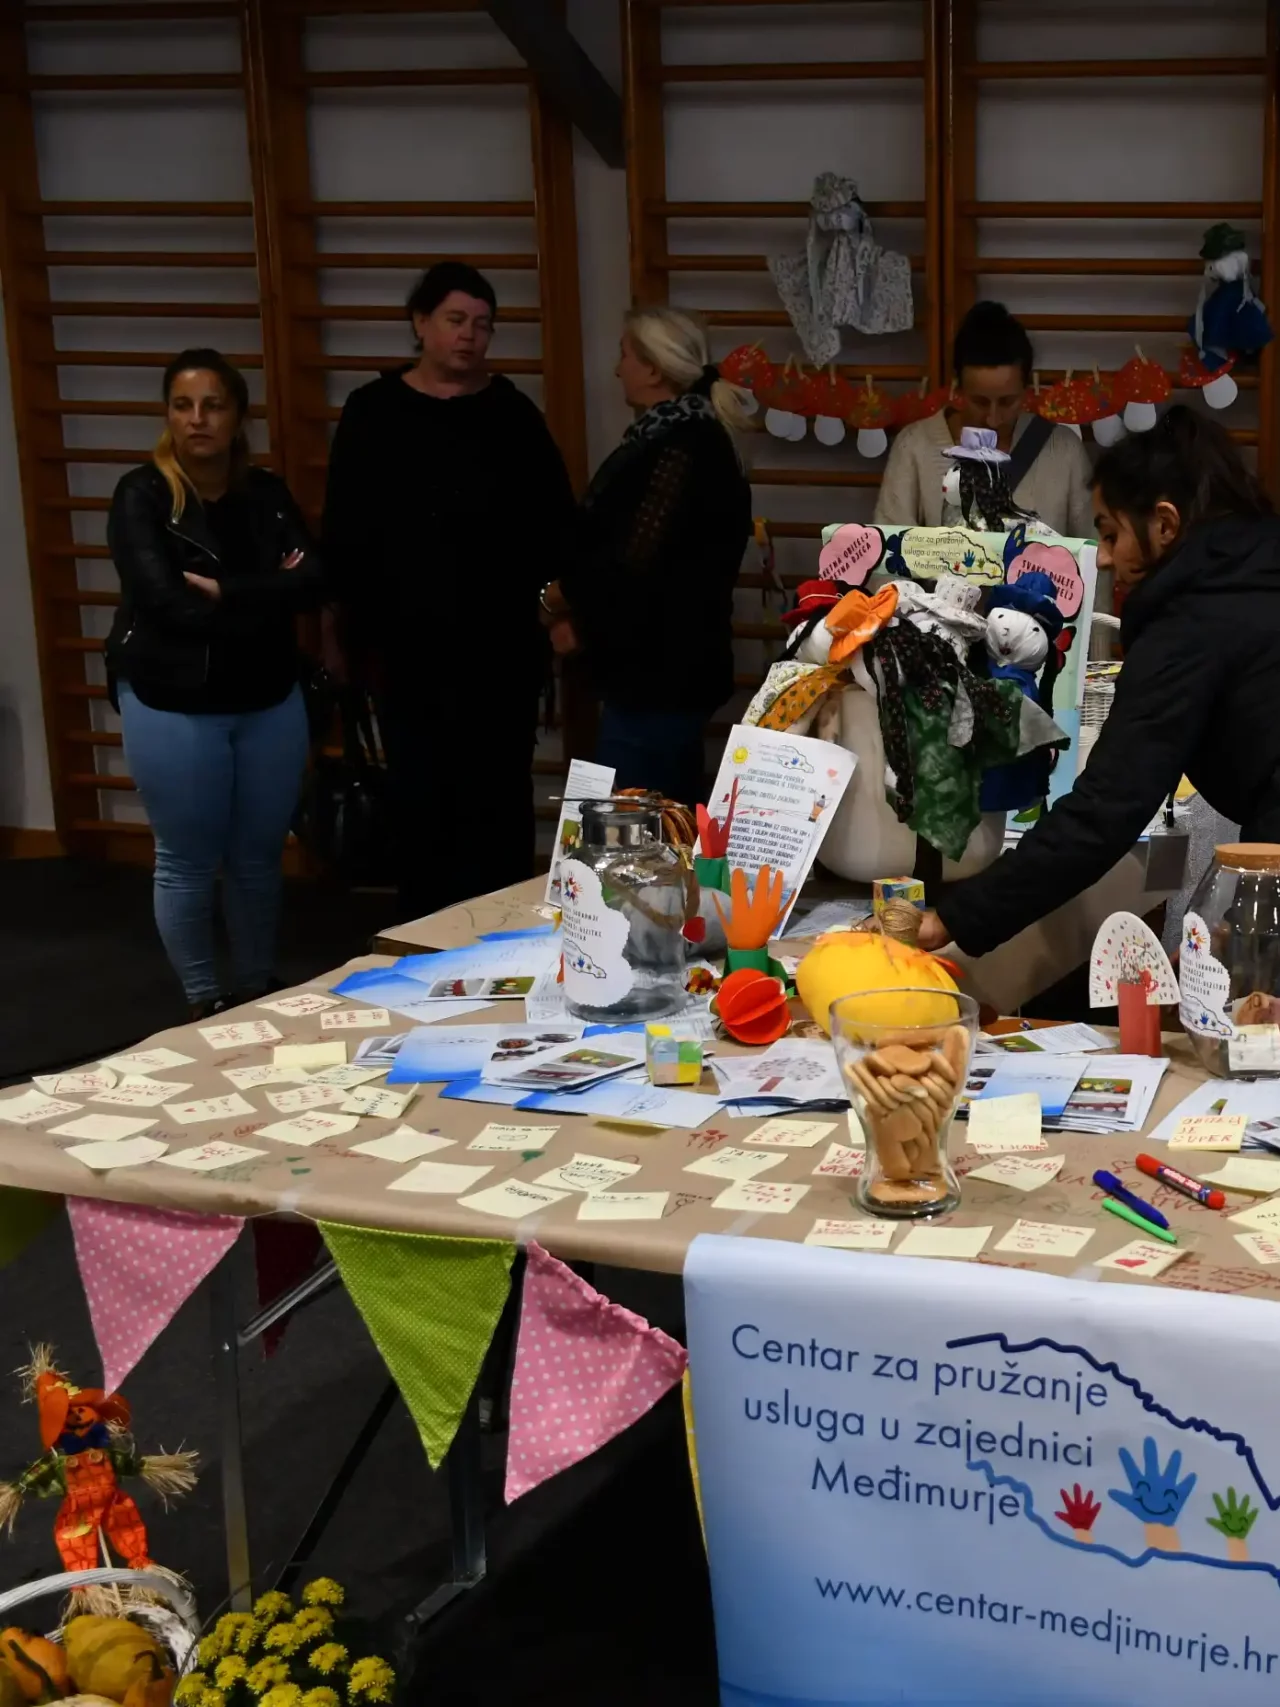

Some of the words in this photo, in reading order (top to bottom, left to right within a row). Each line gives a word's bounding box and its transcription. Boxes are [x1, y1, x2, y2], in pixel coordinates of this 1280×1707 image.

[1173, 1134, 1233, 1143] SUPER
[730, 1323, 859, 1374] Centar
[871, 1350, 919, 1383] za
[934, 1360, 1110, 1415] pružanje
[742, 1389, 865, 1443] usluga
[879, 1415, 901, 1441] u
[914, 1420, 1095, 1470] zajednici
[809, 1457, 1021, 1526] Međimurje
[814, 1574, 1280, 1675] www.centar-medjimurje.hr
